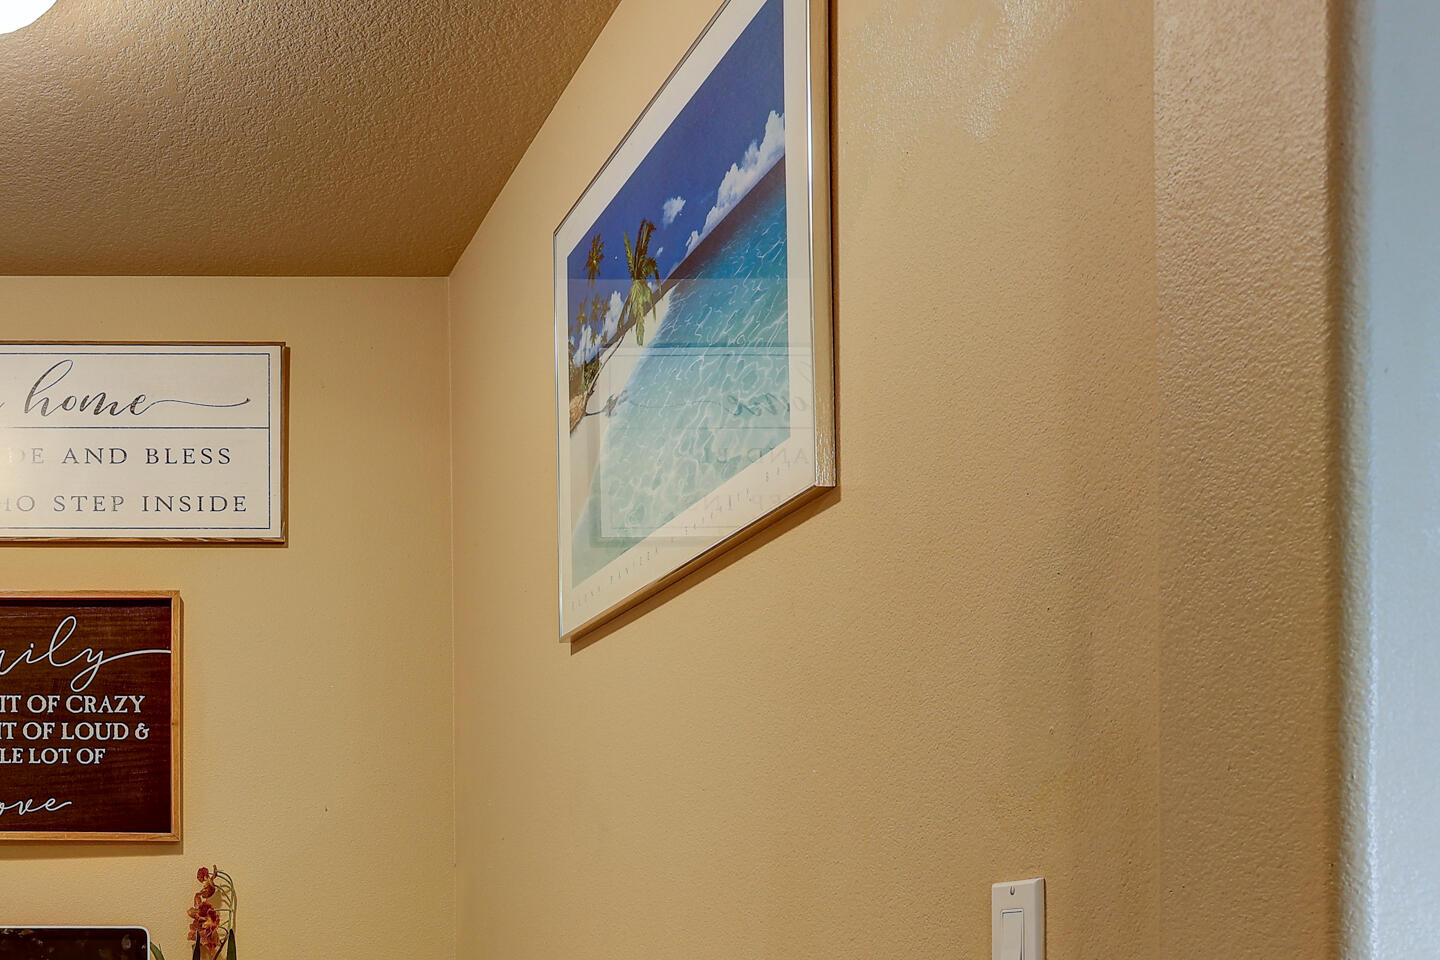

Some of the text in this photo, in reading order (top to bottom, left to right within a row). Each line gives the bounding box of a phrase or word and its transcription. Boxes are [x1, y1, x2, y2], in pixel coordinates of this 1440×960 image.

[24, 359, 155, 417] home
[61, 447, 128, 465] AND
[145, 447, 232, 465] BLESS
[52, 494, 125, 513] STEP
[141, 494, 248, 513] INSIDE
[27, 694, 60, 713] OF
[65, 694, 146, 713] CRAZY
[22, 722, 55, 740] OF
[61, 722, 129, 740] LOUD
[134, 722, 150, 740] &
[28, 748, 71, 764] LOT
[75, 748, 106, 764] OF
